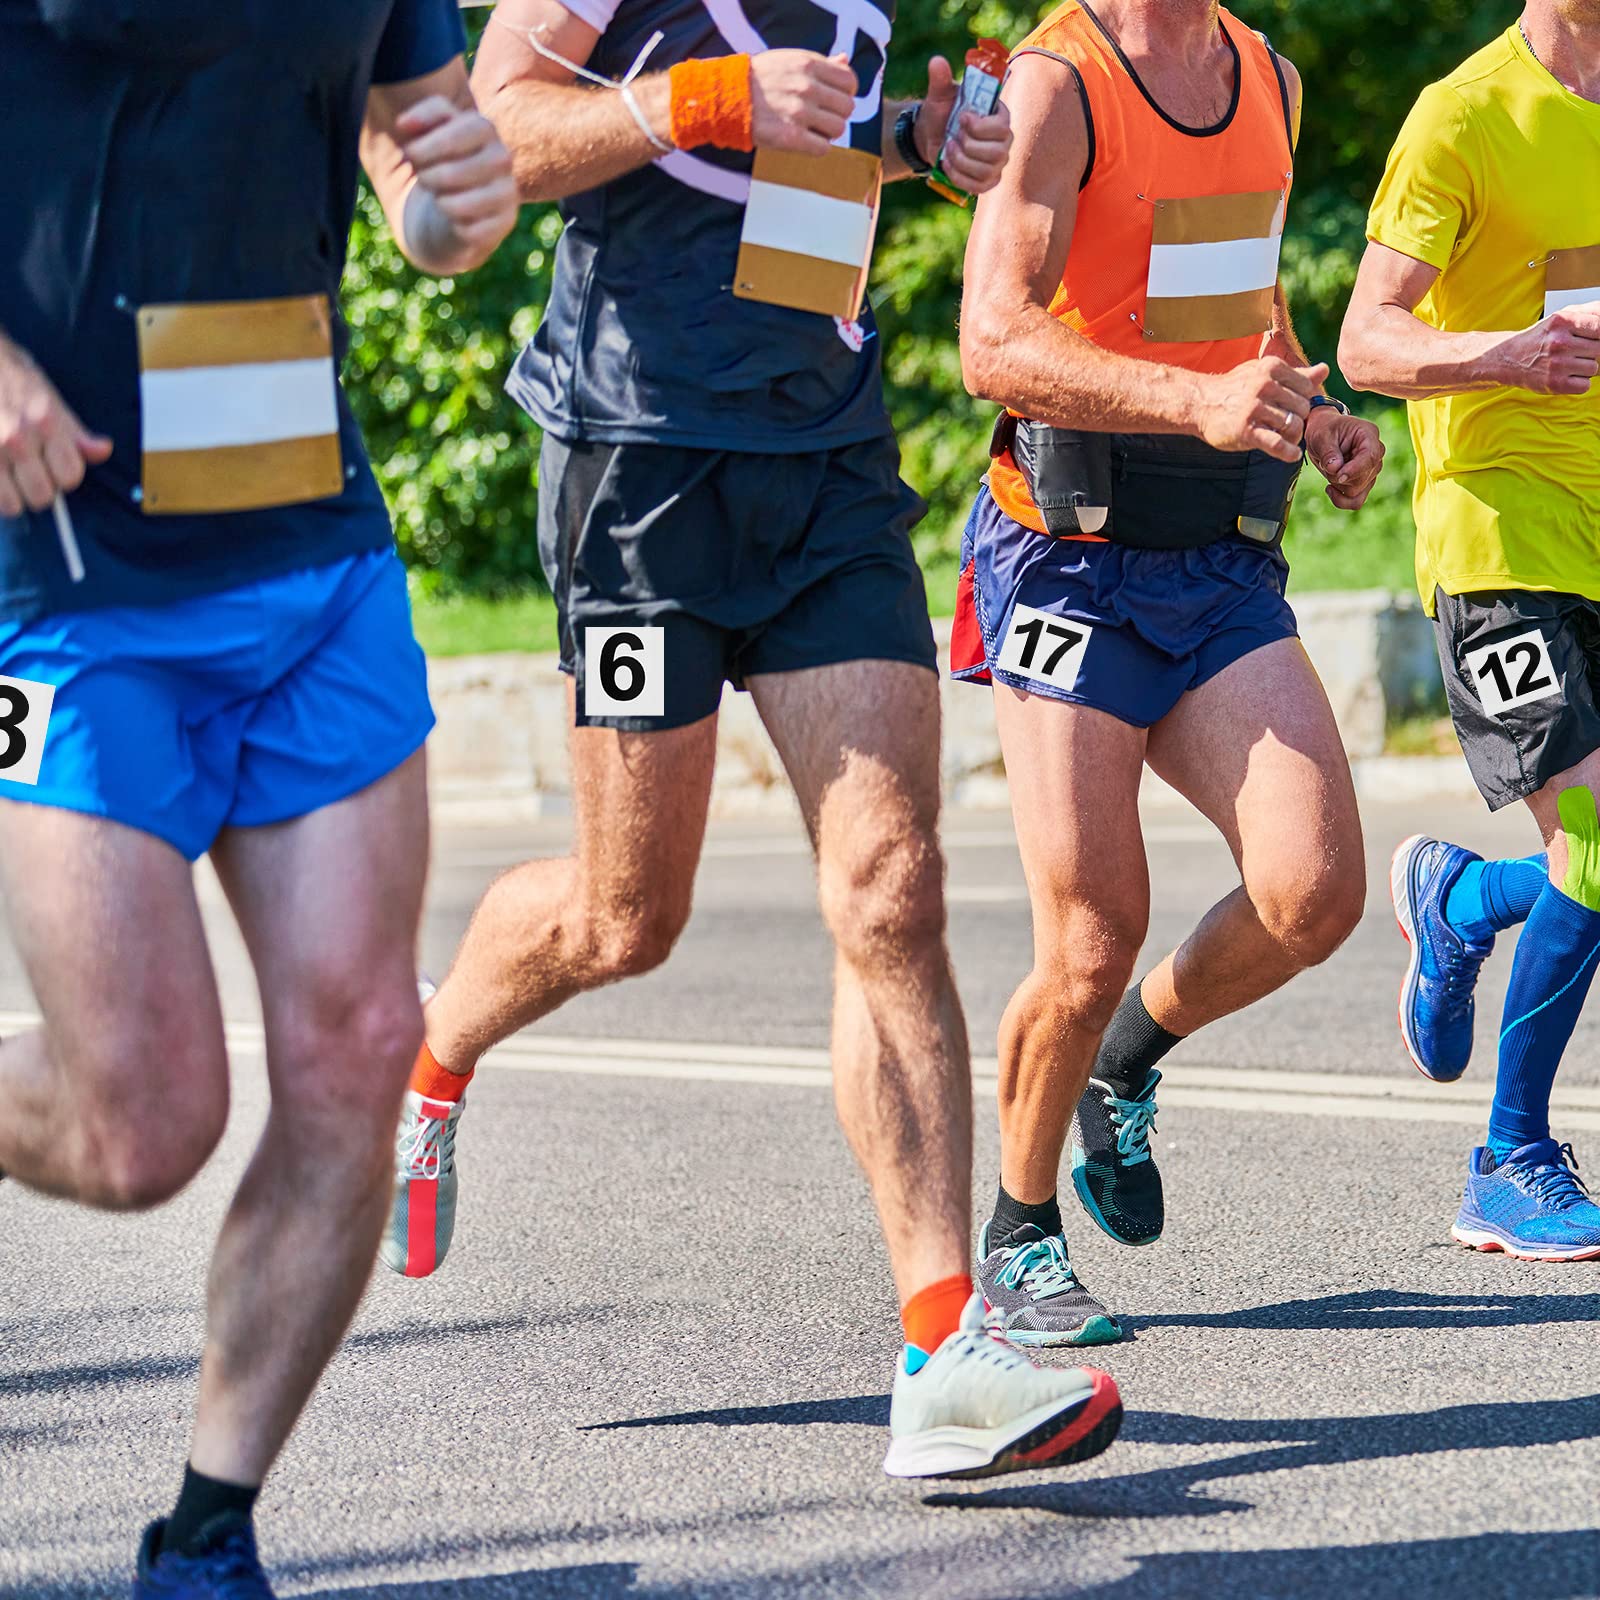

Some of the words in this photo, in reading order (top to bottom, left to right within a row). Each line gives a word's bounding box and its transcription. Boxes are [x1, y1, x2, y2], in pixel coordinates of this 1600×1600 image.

[600, 633, 645, 701] 6
[1015, 619, 1083, 675] 17
[1478, 642, 1551, 702] 12
